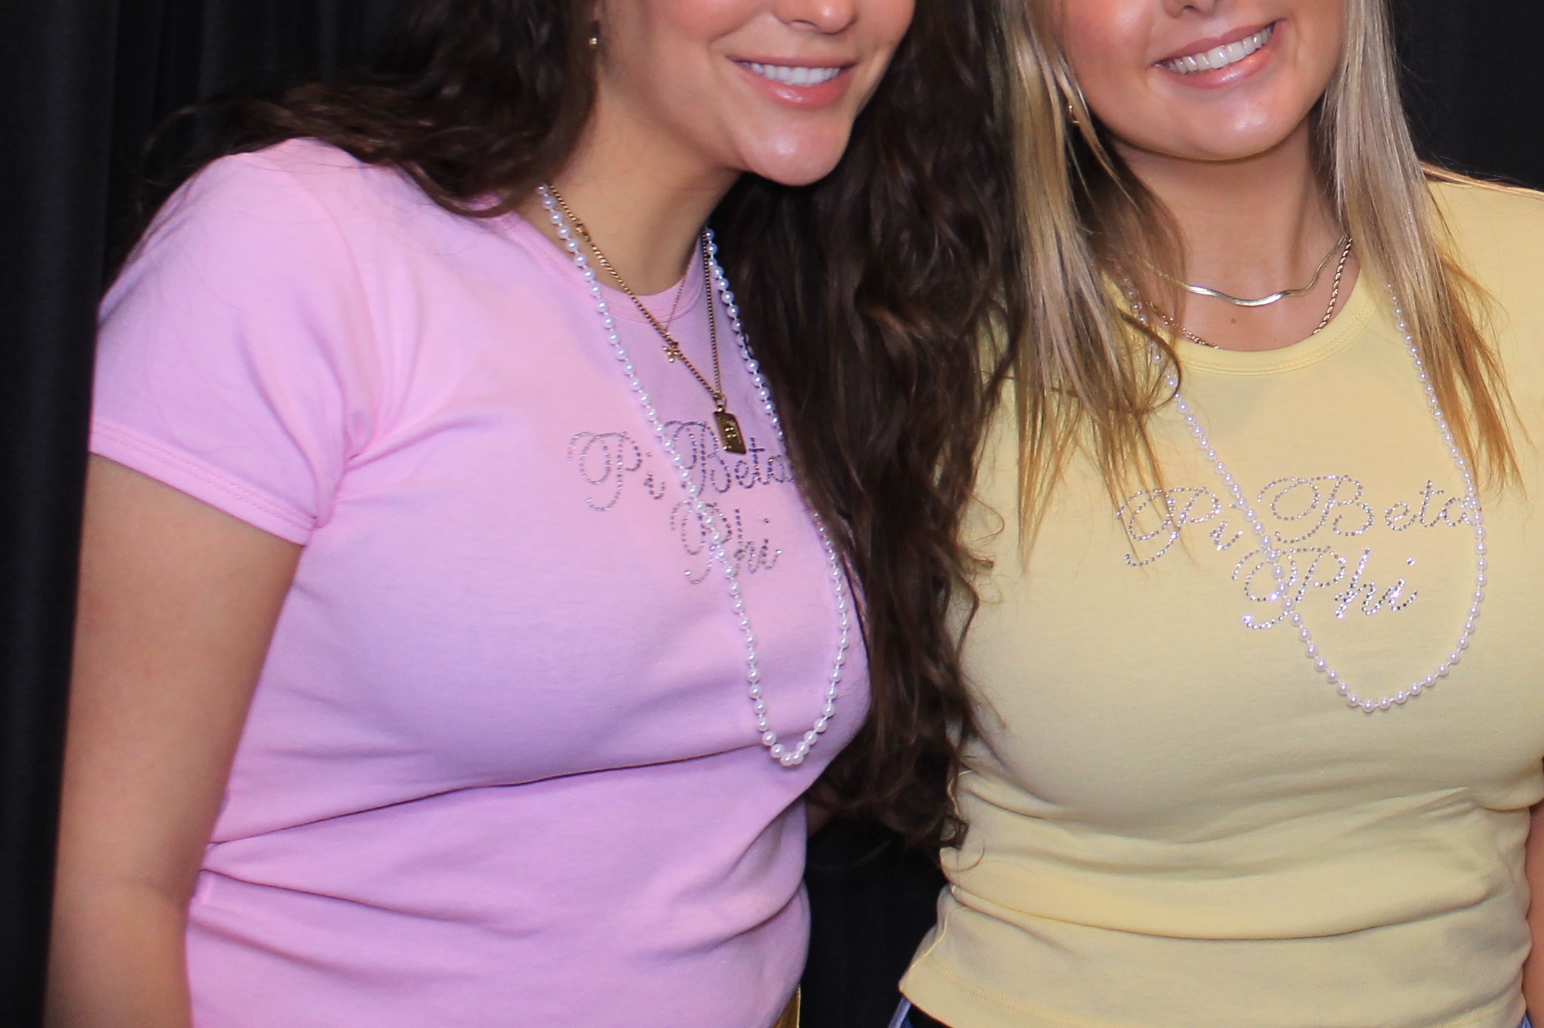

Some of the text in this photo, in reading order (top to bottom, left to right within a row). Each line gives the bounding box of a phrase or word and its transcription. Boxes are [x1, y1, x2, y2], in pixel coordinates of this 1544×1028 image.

[567, 421, 796, 511] Pi Beta
[671, 500, 783, 584] Phi
[1116, 474, 1475, 566] Pi Beta
[1231, 546, 1419, 630] Phi
